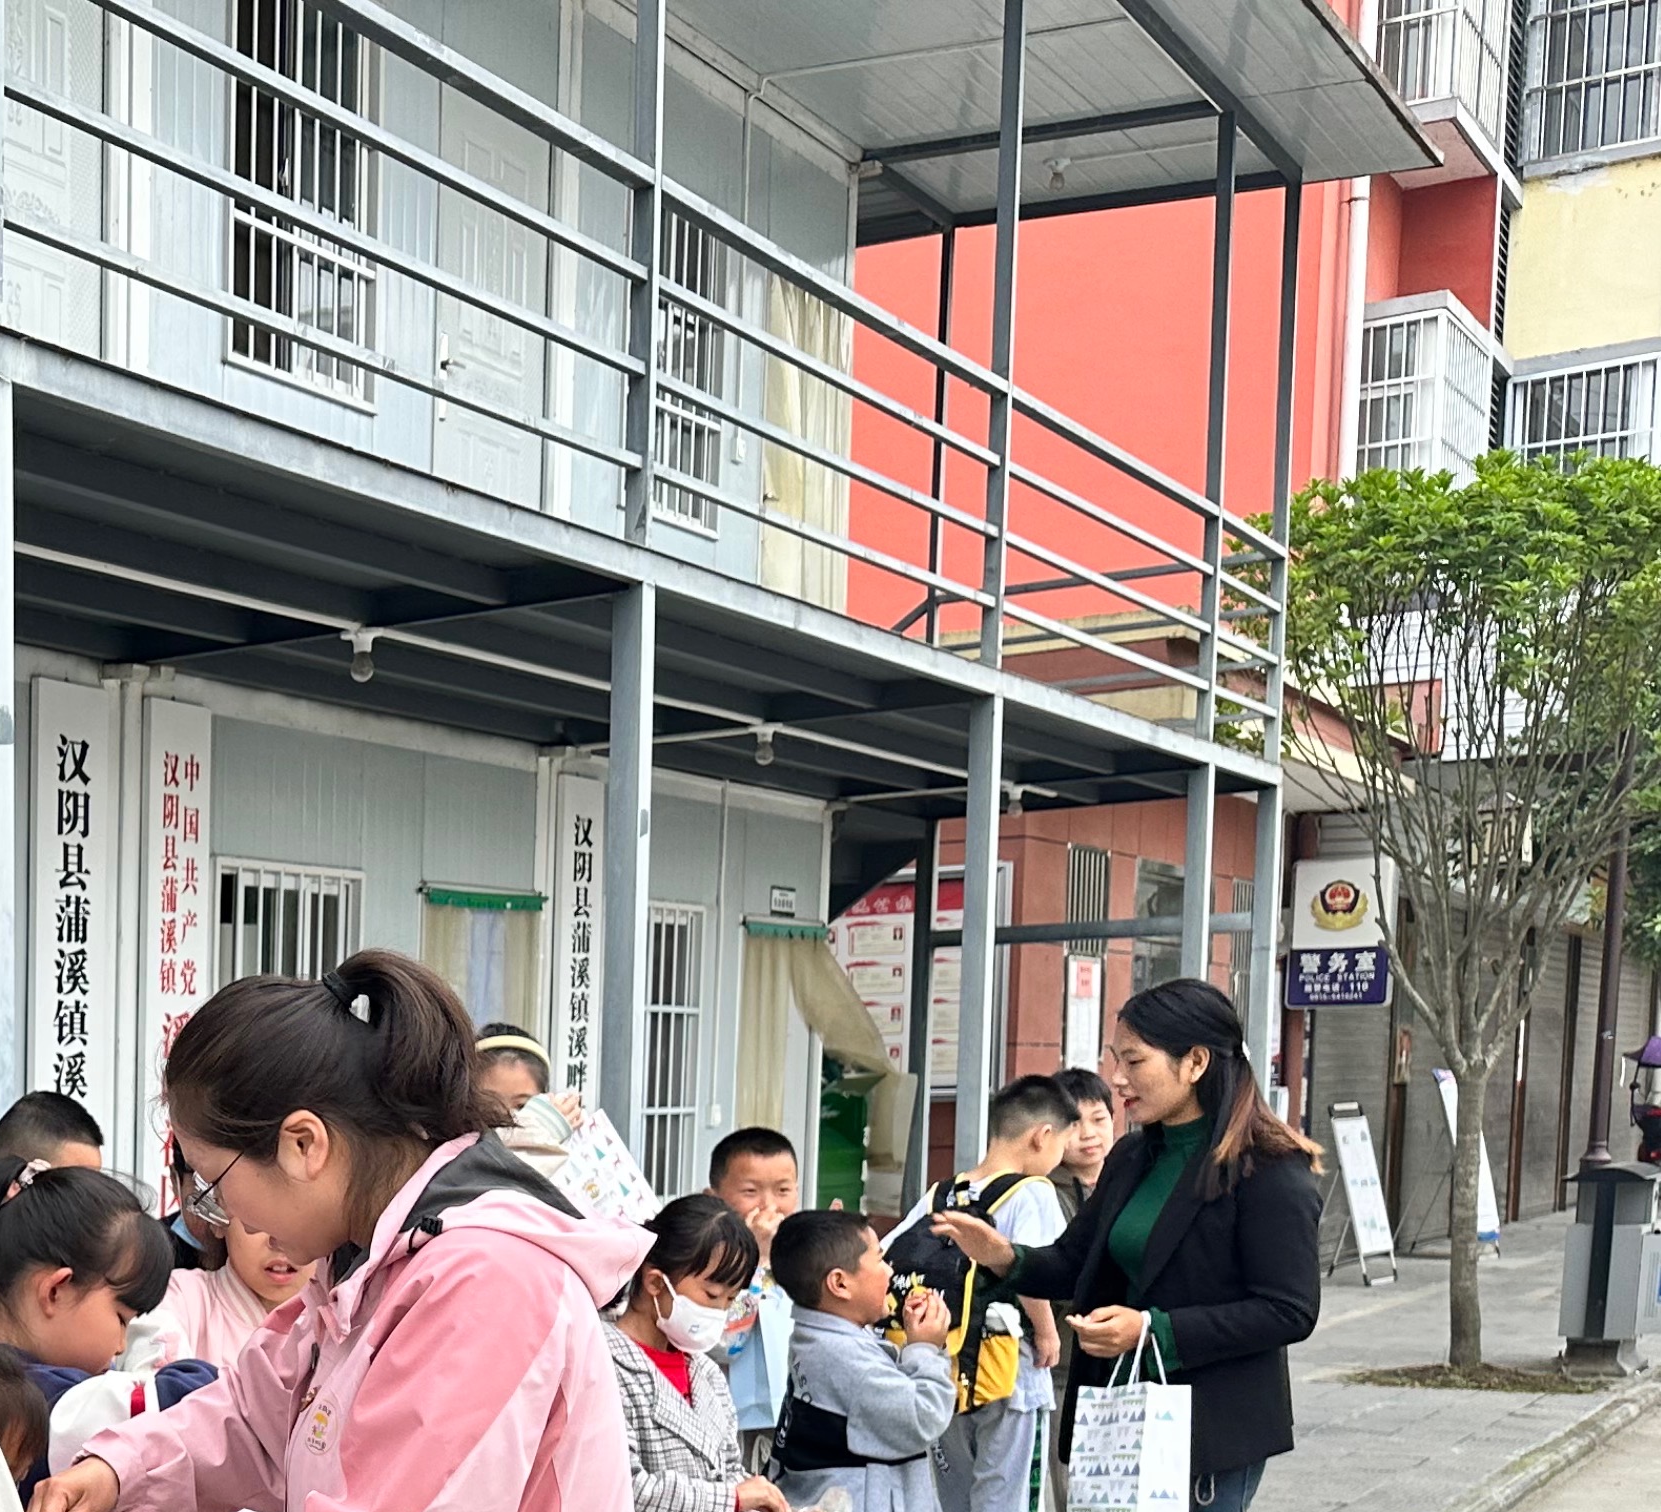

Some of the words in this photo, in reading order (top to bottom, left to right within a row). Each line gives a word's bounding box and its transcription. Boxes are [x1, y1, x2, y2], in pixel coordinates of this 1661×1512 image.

[159, 749, 181, 995] 汉阴县蒲溪镇
[180, 752, 201, 996] 中国共产党
[565, 814, 593, 1109] 汉阴县蒲溪镇溪畔
[1299, 950, 1377, 974] 警务室
[1299, 973, 1331, 984] POLICE
[1337, 971, 1375, 982] STATION
